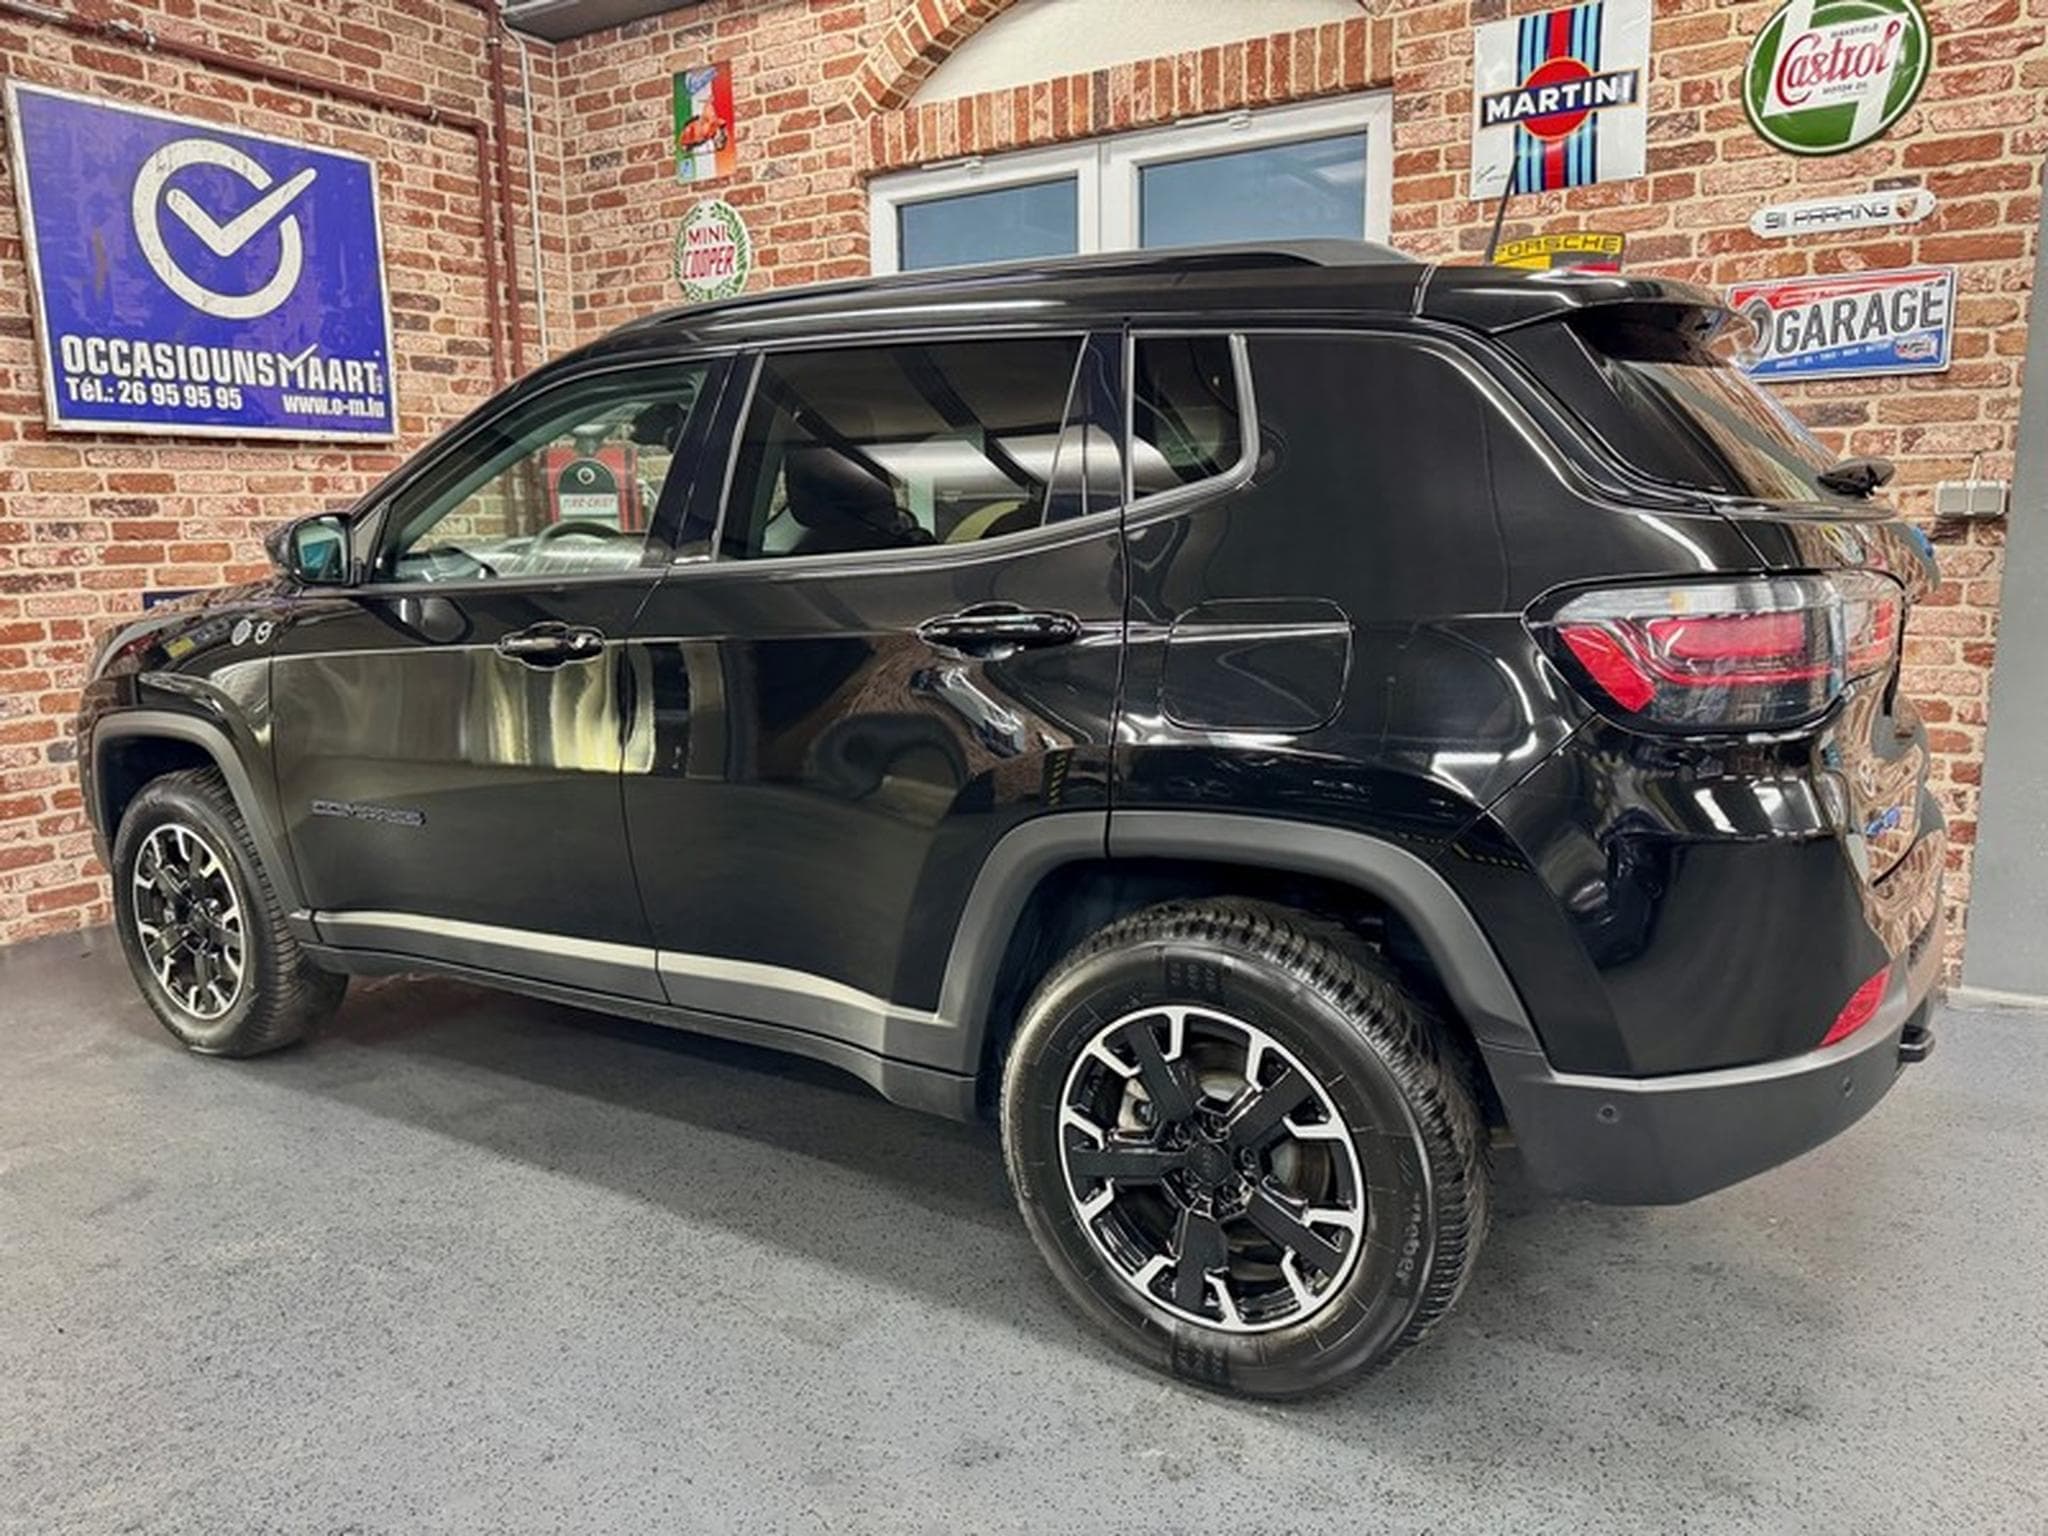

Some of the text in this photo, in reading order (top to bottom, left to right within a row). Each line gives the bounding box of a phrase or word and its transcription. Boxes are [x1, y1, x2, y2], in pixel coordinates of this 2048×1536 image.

[1776, 20, 1901, 107] Castrol
[1486, 73, 1634, 123] MARTINI
[1793, 202, 1890, 226] PARKING
[687, 225, 726, 246] MINI
[682, 247, 735, 279] COOPER
[1775, 278, 1946, 355] GARAGE
[65, 376, 243, 411] Tél.: 26 95 95 95
[282, 394, 385, 418] www.o-m.lu
